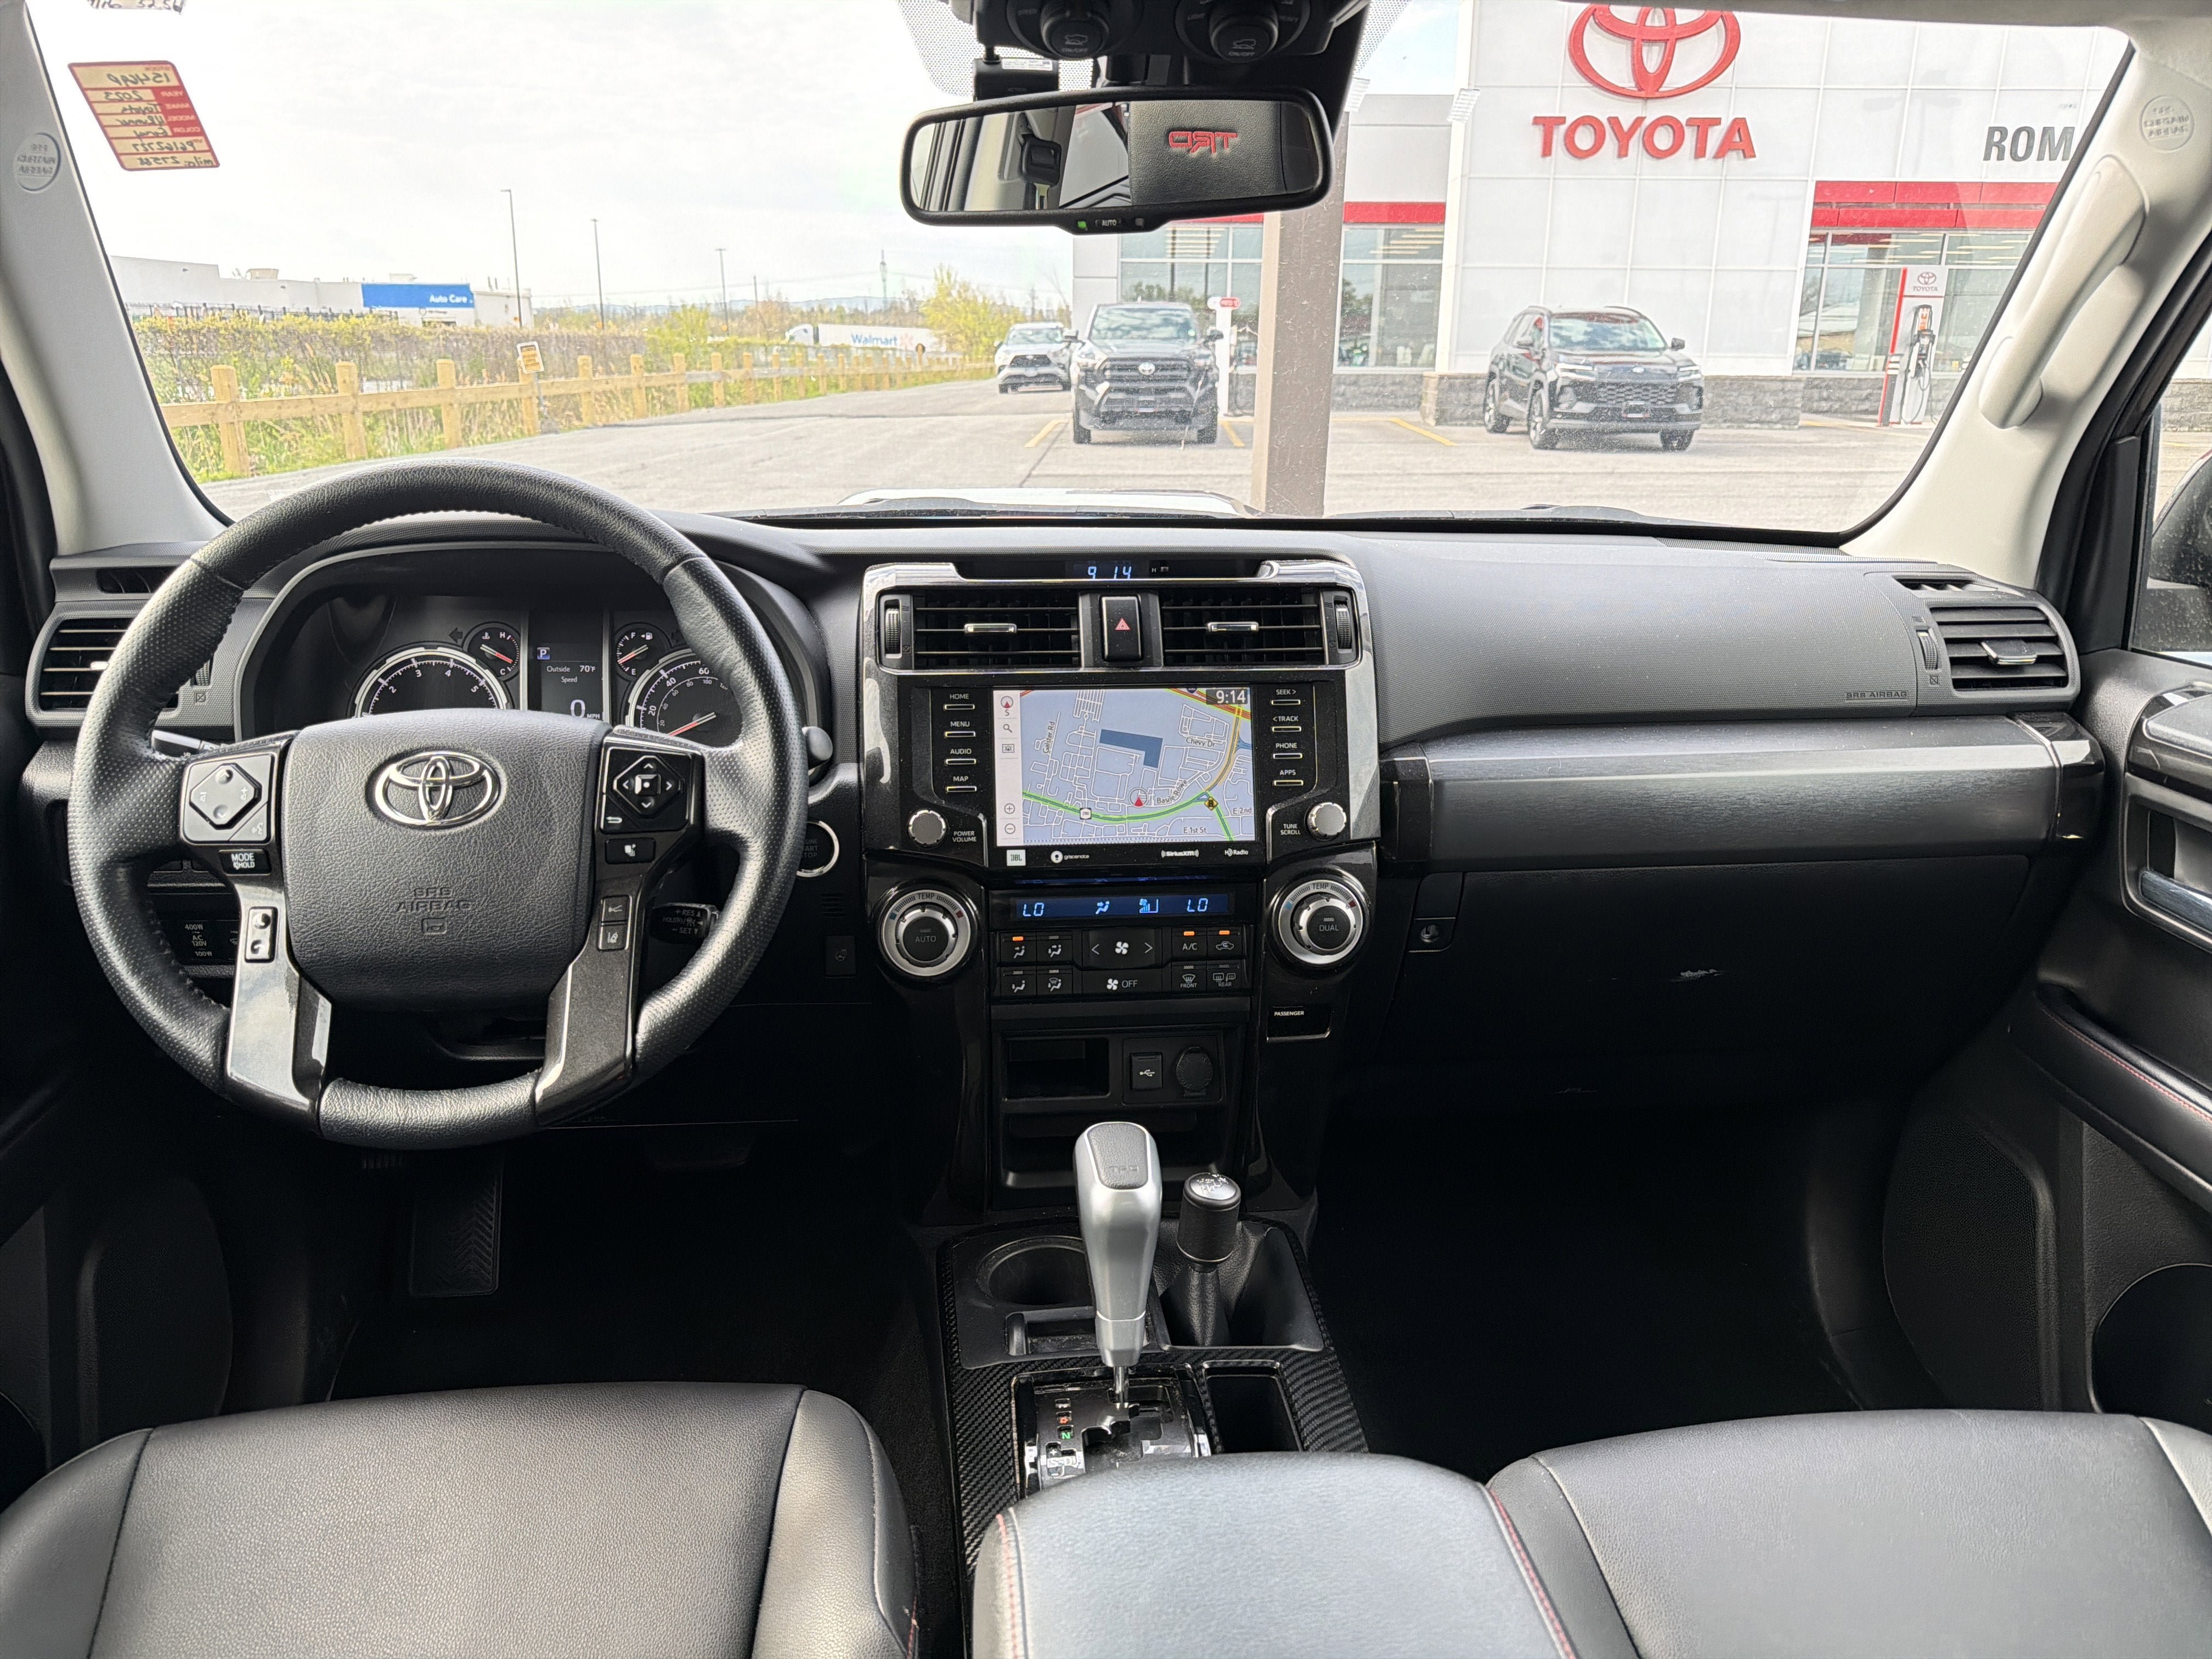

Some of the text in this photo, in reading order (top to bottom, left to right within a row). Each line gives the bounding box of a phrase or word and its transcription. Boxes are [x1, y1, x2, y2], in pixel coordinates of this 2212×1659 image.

[1531, 115, 1757, 159] TOYOTA
[430, 294, 467, 303] Auto Care
[851, 334, 898, 346] Walmart
[666, 677, 676, 687] 40
[1215, 690, 1246, 704] 9:14
[571, 699, 586, 718] 0
[648, 705, 657, 716] 20
[1047, 721, 1056, 732] Rd
[1186, 737, 1205, 748] Chevy
[231, 853, 255, 862] MODE
[1312, 882, 1329, 890] TEMP
[396, 900, 471, 913] AIRBAG
[1182, 942, 1198, 951] A/C
[1121, 979, 1138, 988] OFF
